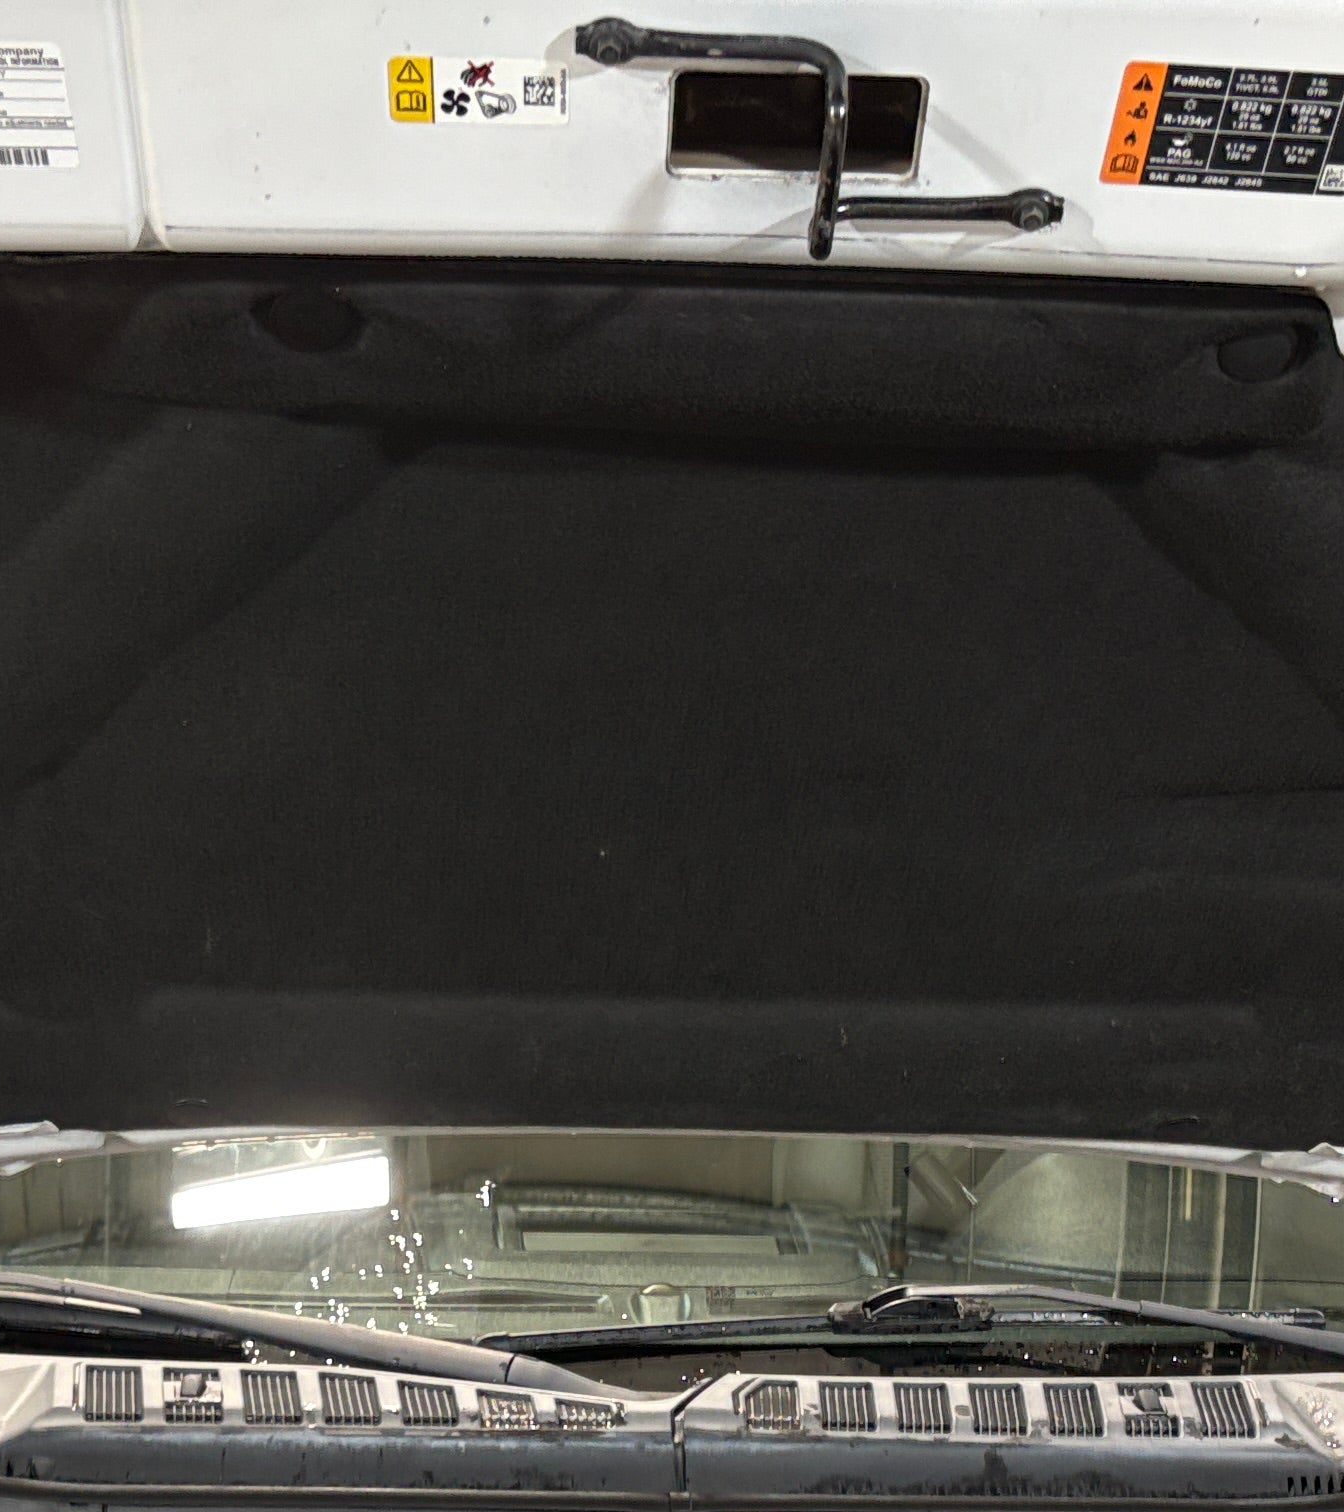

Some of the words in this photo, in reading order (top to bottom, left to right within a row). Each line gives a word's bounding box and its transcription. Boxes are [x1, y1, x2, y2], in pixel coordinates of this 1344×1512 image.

[1173, 75, 1223, 89] FoMoCo
[1260, 102, 1273, 116] kg
[1163, 113, 1213, 128] R-1234yf
[1167, 148, 1192, 158] PAG
[1149, 172, 1170, 182] SAE
